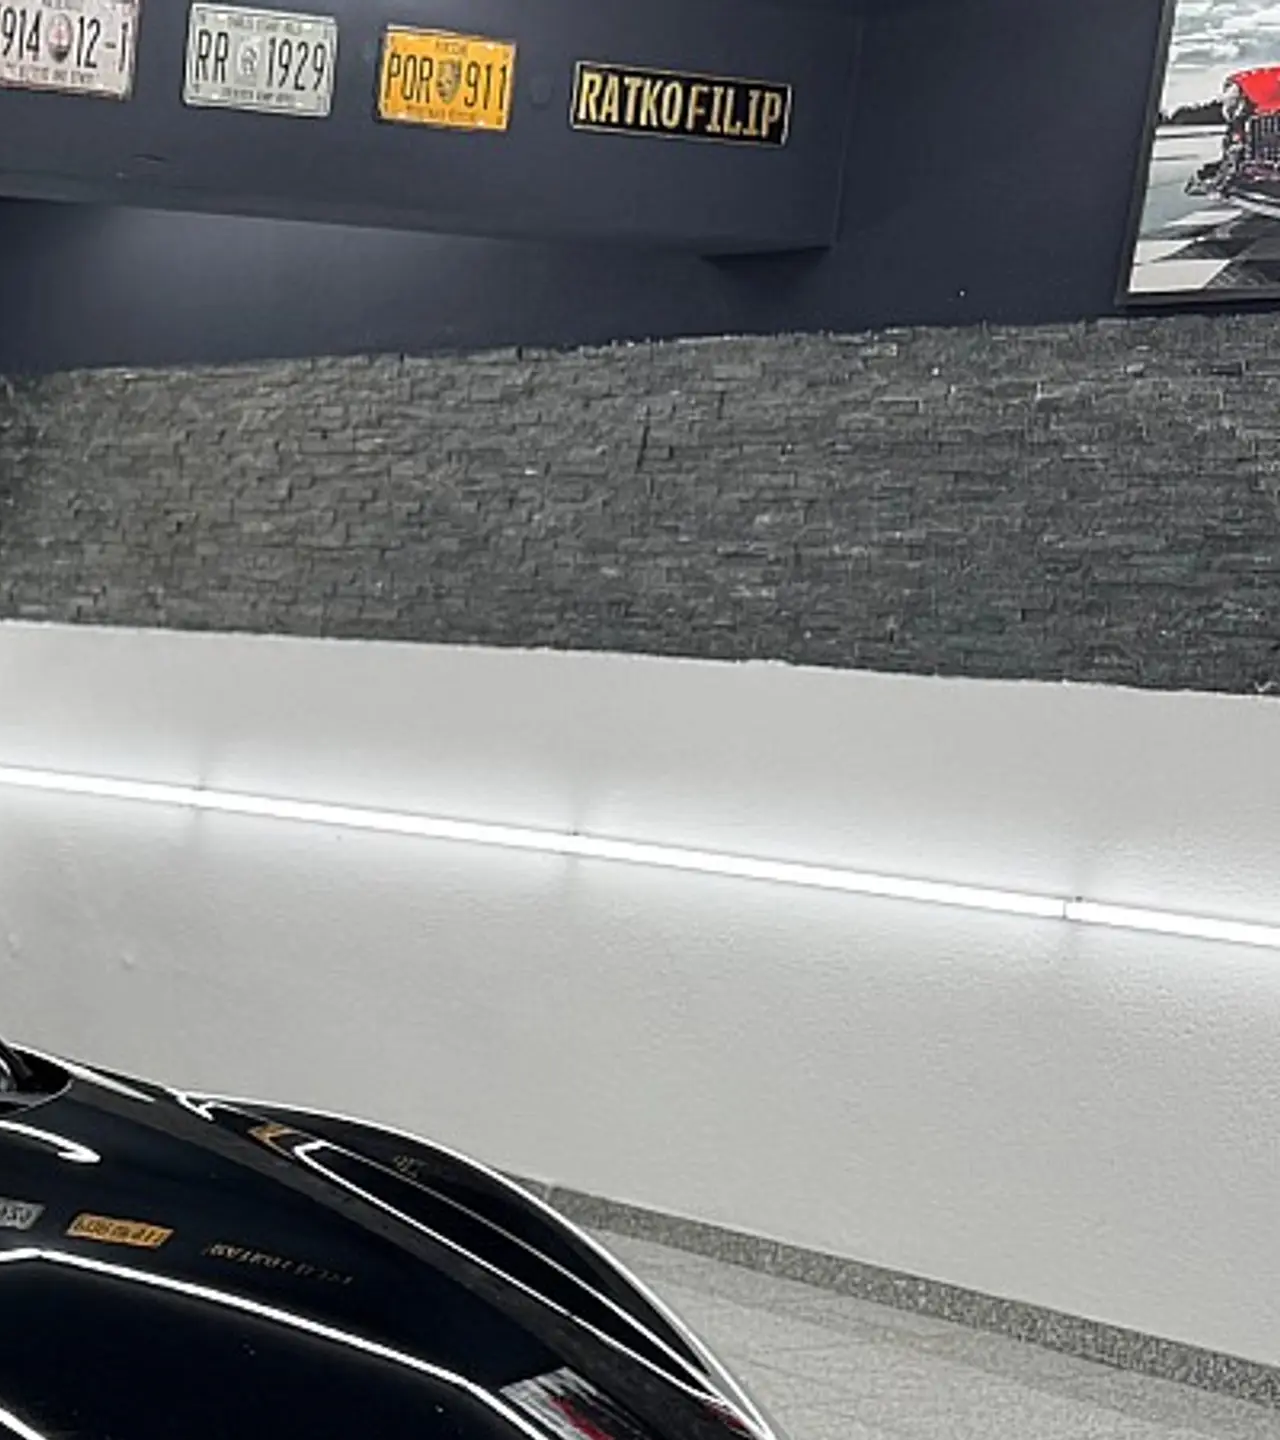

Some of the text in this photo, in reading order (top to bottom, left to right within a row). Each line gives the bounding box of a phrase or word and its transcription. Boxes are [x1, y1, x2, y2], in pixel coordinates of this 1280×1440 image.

[195, 29, 327, 92] RR 1929
[385, 51, 507, 111] POR 911
